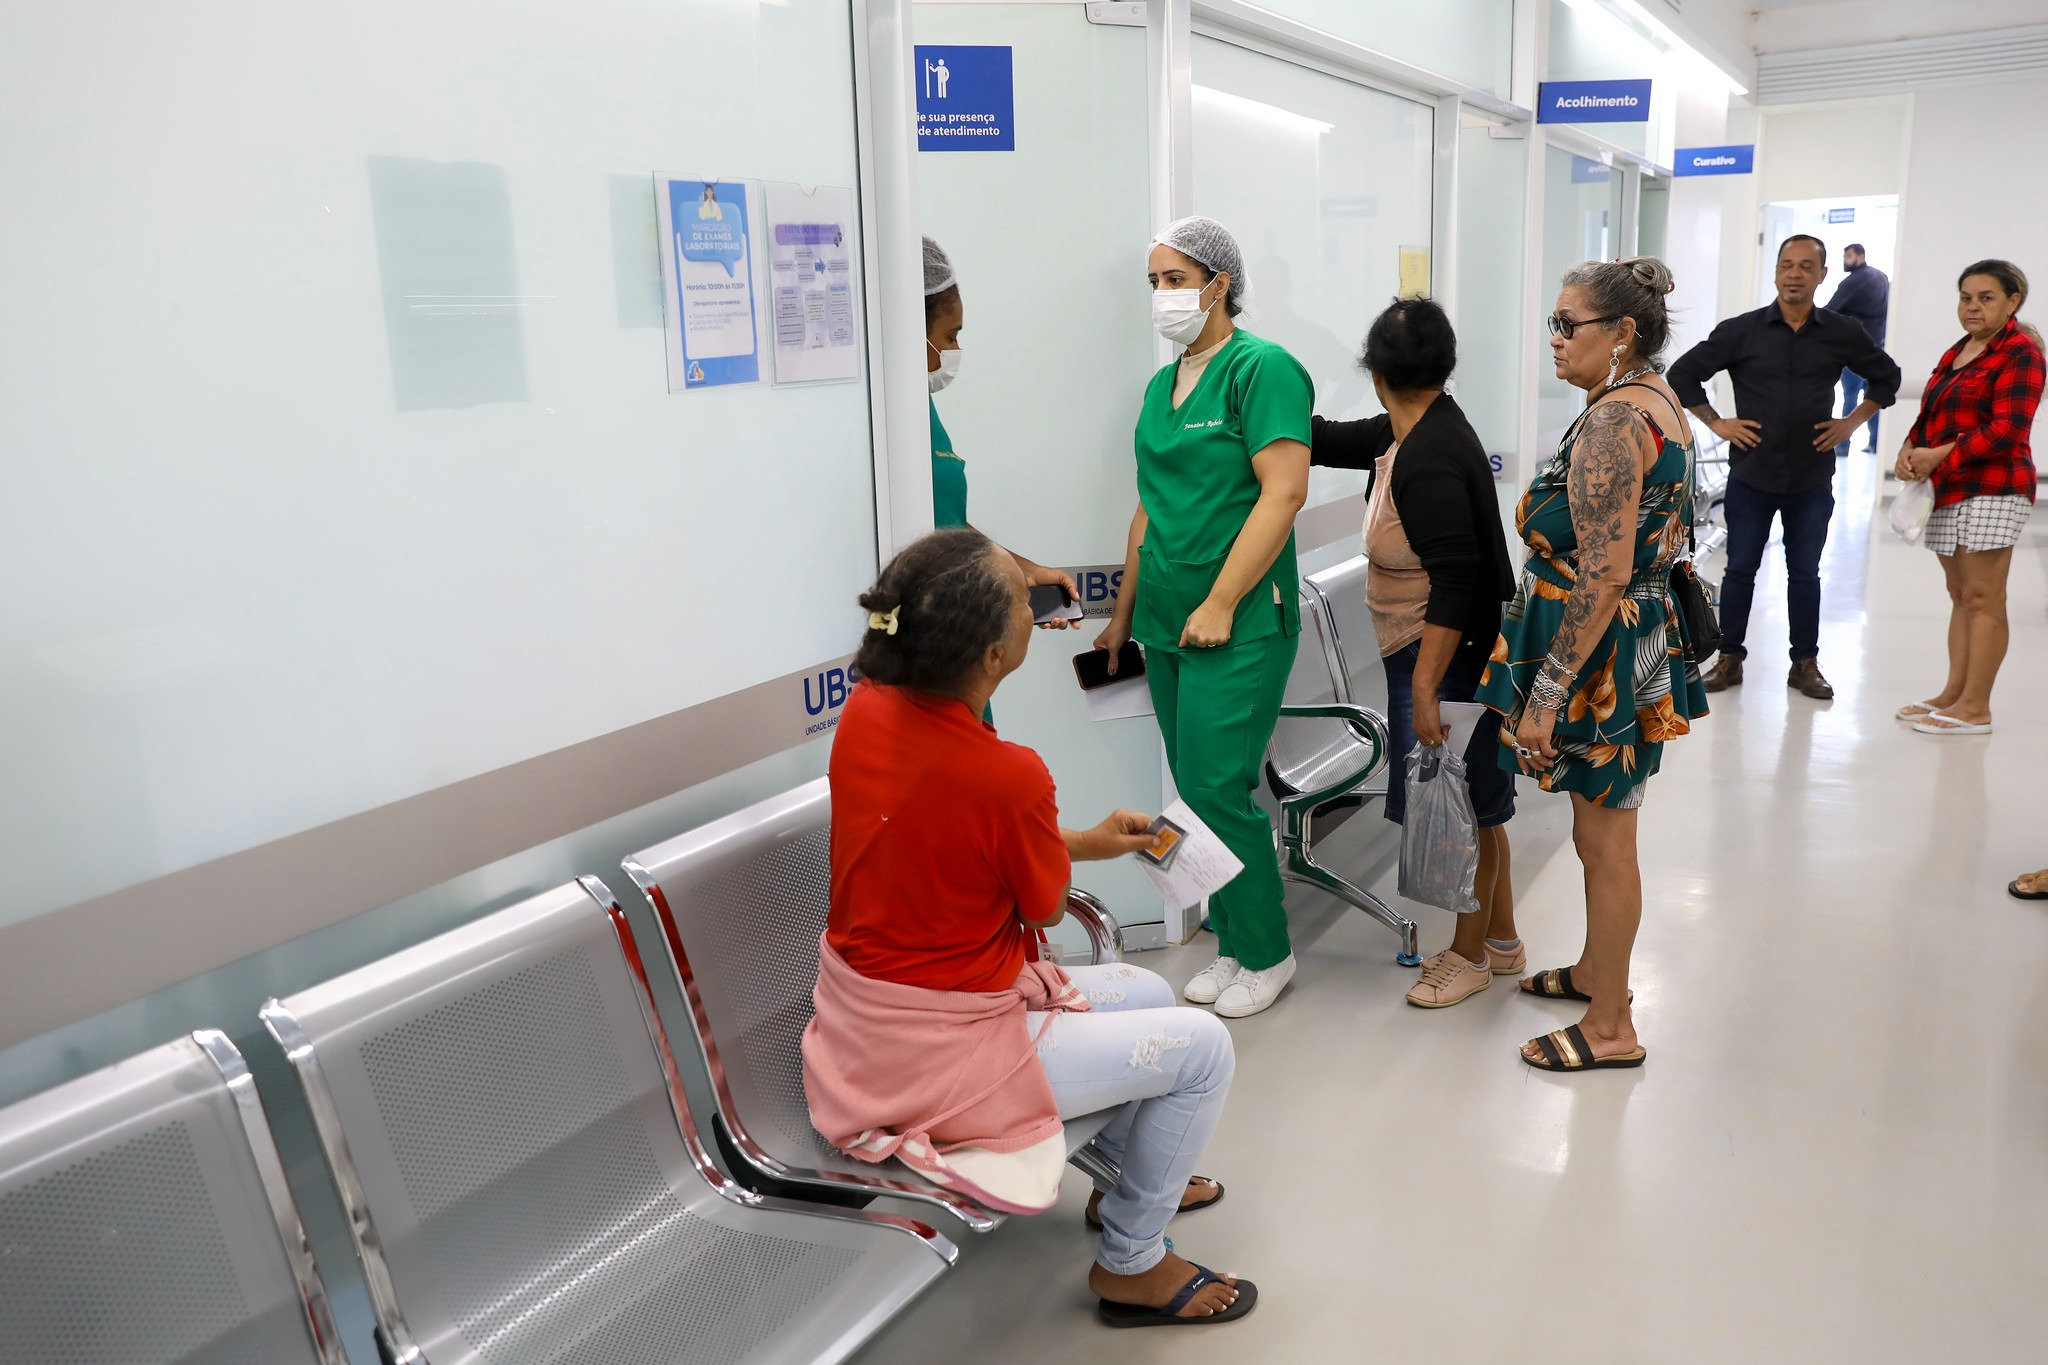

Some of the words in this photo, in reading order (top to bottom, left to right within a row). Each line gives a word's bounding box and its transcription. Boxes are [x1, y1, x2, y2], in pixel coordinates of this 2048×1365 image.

[1556, 95, 1638, 108] Acolhimento
[928, 114, 946, 122] sua
[949, 114, 995, 124] presença
[918, 126, 931, 136] de
[933, 126, 1000, 136] atendimento
[1693, 156, 1736, 167] Curativo
[693, 232, 703, 241] DE
[704, 232, 732, 241] EXAMES
[686, 242, 740, 250] LABORATORIAIS
[805, 720, 827, 736] UNIDADE
